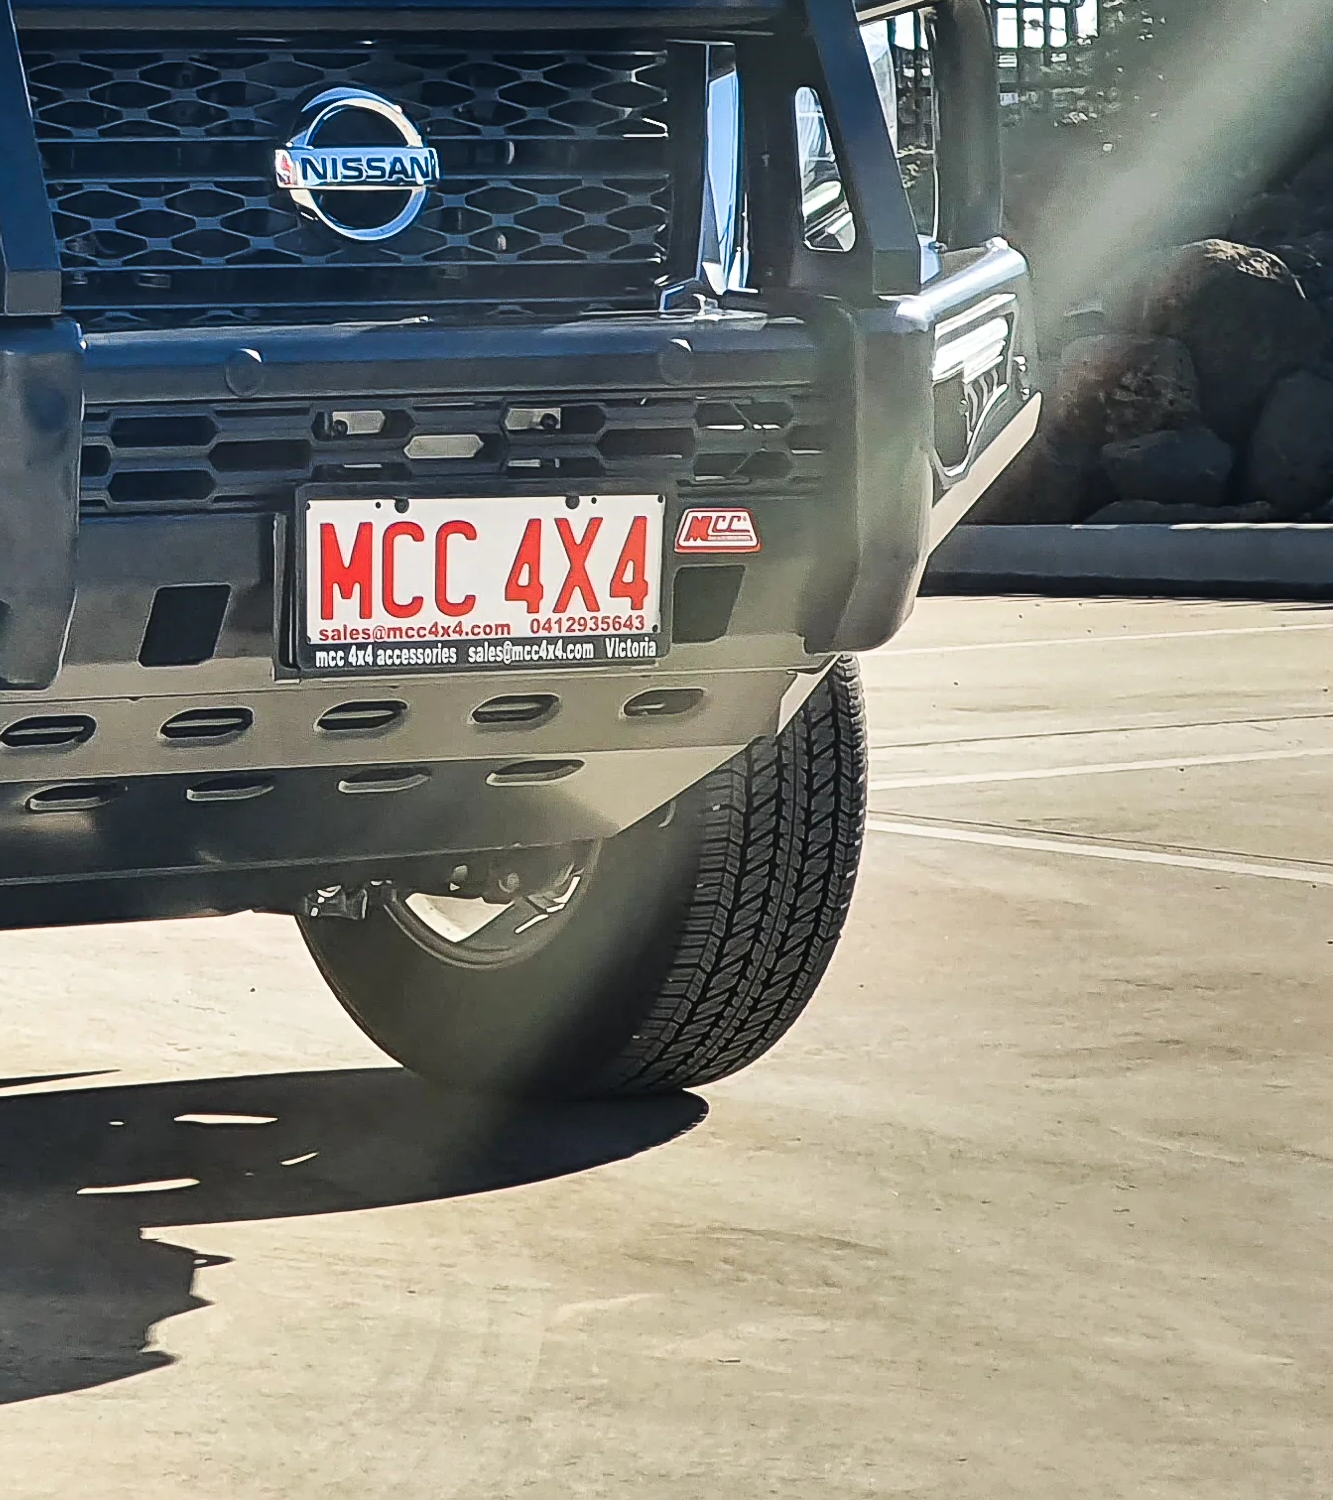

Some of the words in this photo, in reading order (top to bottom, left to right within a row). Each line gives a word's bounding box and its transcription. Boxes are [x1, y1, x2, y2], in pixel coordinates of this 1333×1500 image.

[300, 156, 430, 182] NISSAN
[320, 520, 477, 621] MCC
[504, 516, 650, 615] 4X4
[319, 621, 511, 641] sales@mcc4x4.com
[530, 615, 646, 635] 0412935643
[315, 650, 344, 668] mcc
[347, 645, 374, 667] 4x4
[377, 644, 457, 666] accessories
[468, 639, 594, 665] sales@mcc4x4.com
[605, 637, 657, 659] Victoria
